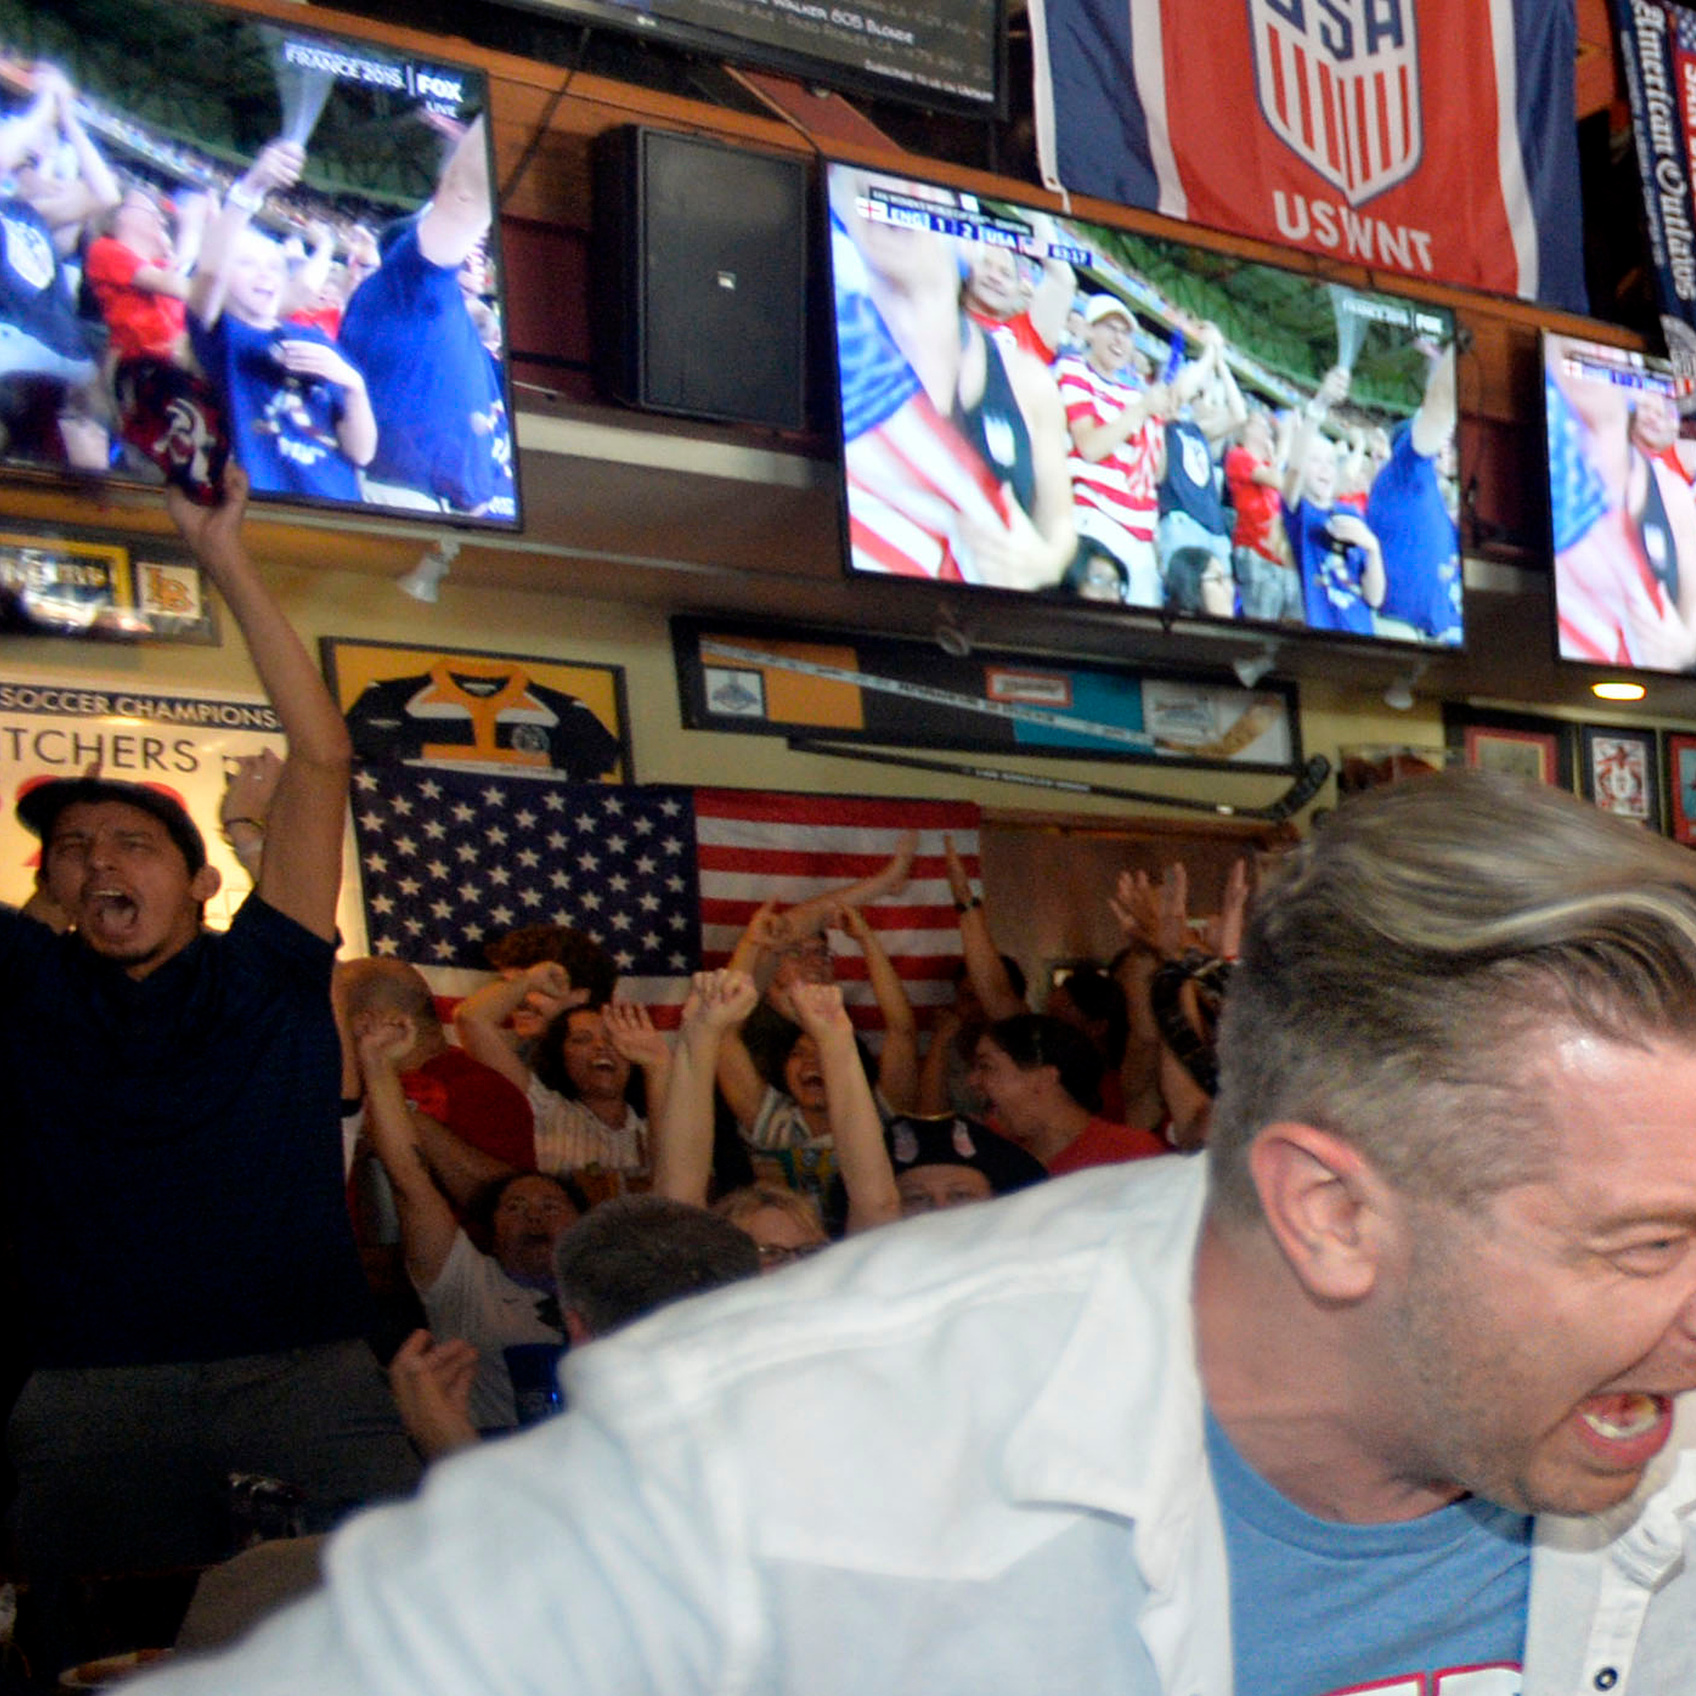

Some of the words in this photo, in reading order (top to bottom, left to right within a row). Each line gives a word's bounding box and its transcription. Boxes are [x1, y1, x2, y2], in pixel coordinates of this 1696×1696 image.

[831, 6, 865, 30] 605
[416, 73, 464, 103] FOX
[985, 227, 1018, 249] USA
[1273, 190, 1434, 273] USWNT
[0, 688, 110, 715] SOCCER
